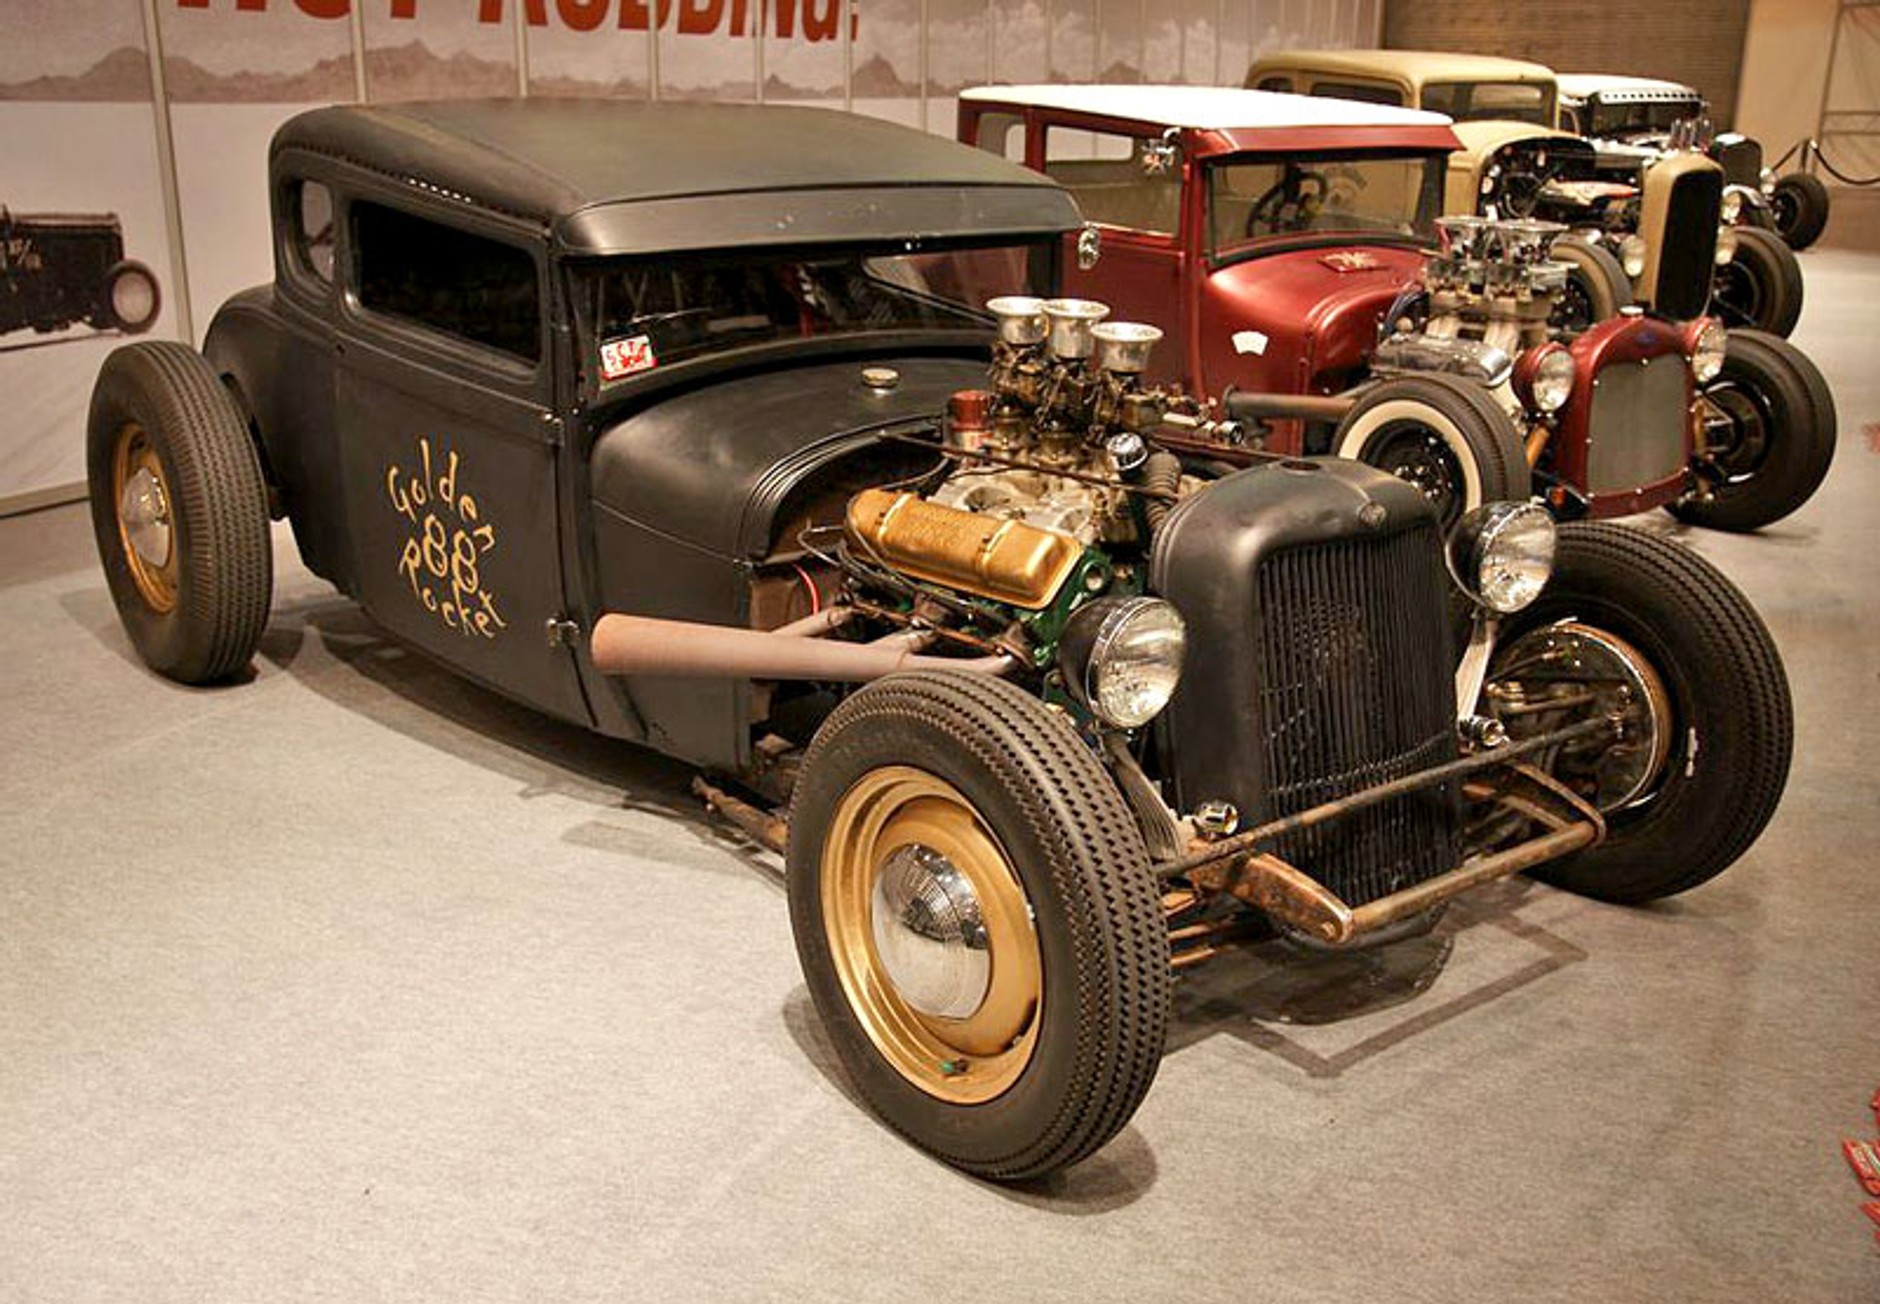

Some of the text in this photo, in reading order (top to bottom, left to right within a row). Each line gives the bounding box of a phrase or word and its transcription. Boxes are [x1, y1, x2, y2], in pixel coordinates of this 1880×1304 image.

[388, 438, 496, 553] Golden
[398, 537, 507, 639] Rocket
[422, 513, 479, 595] 88
